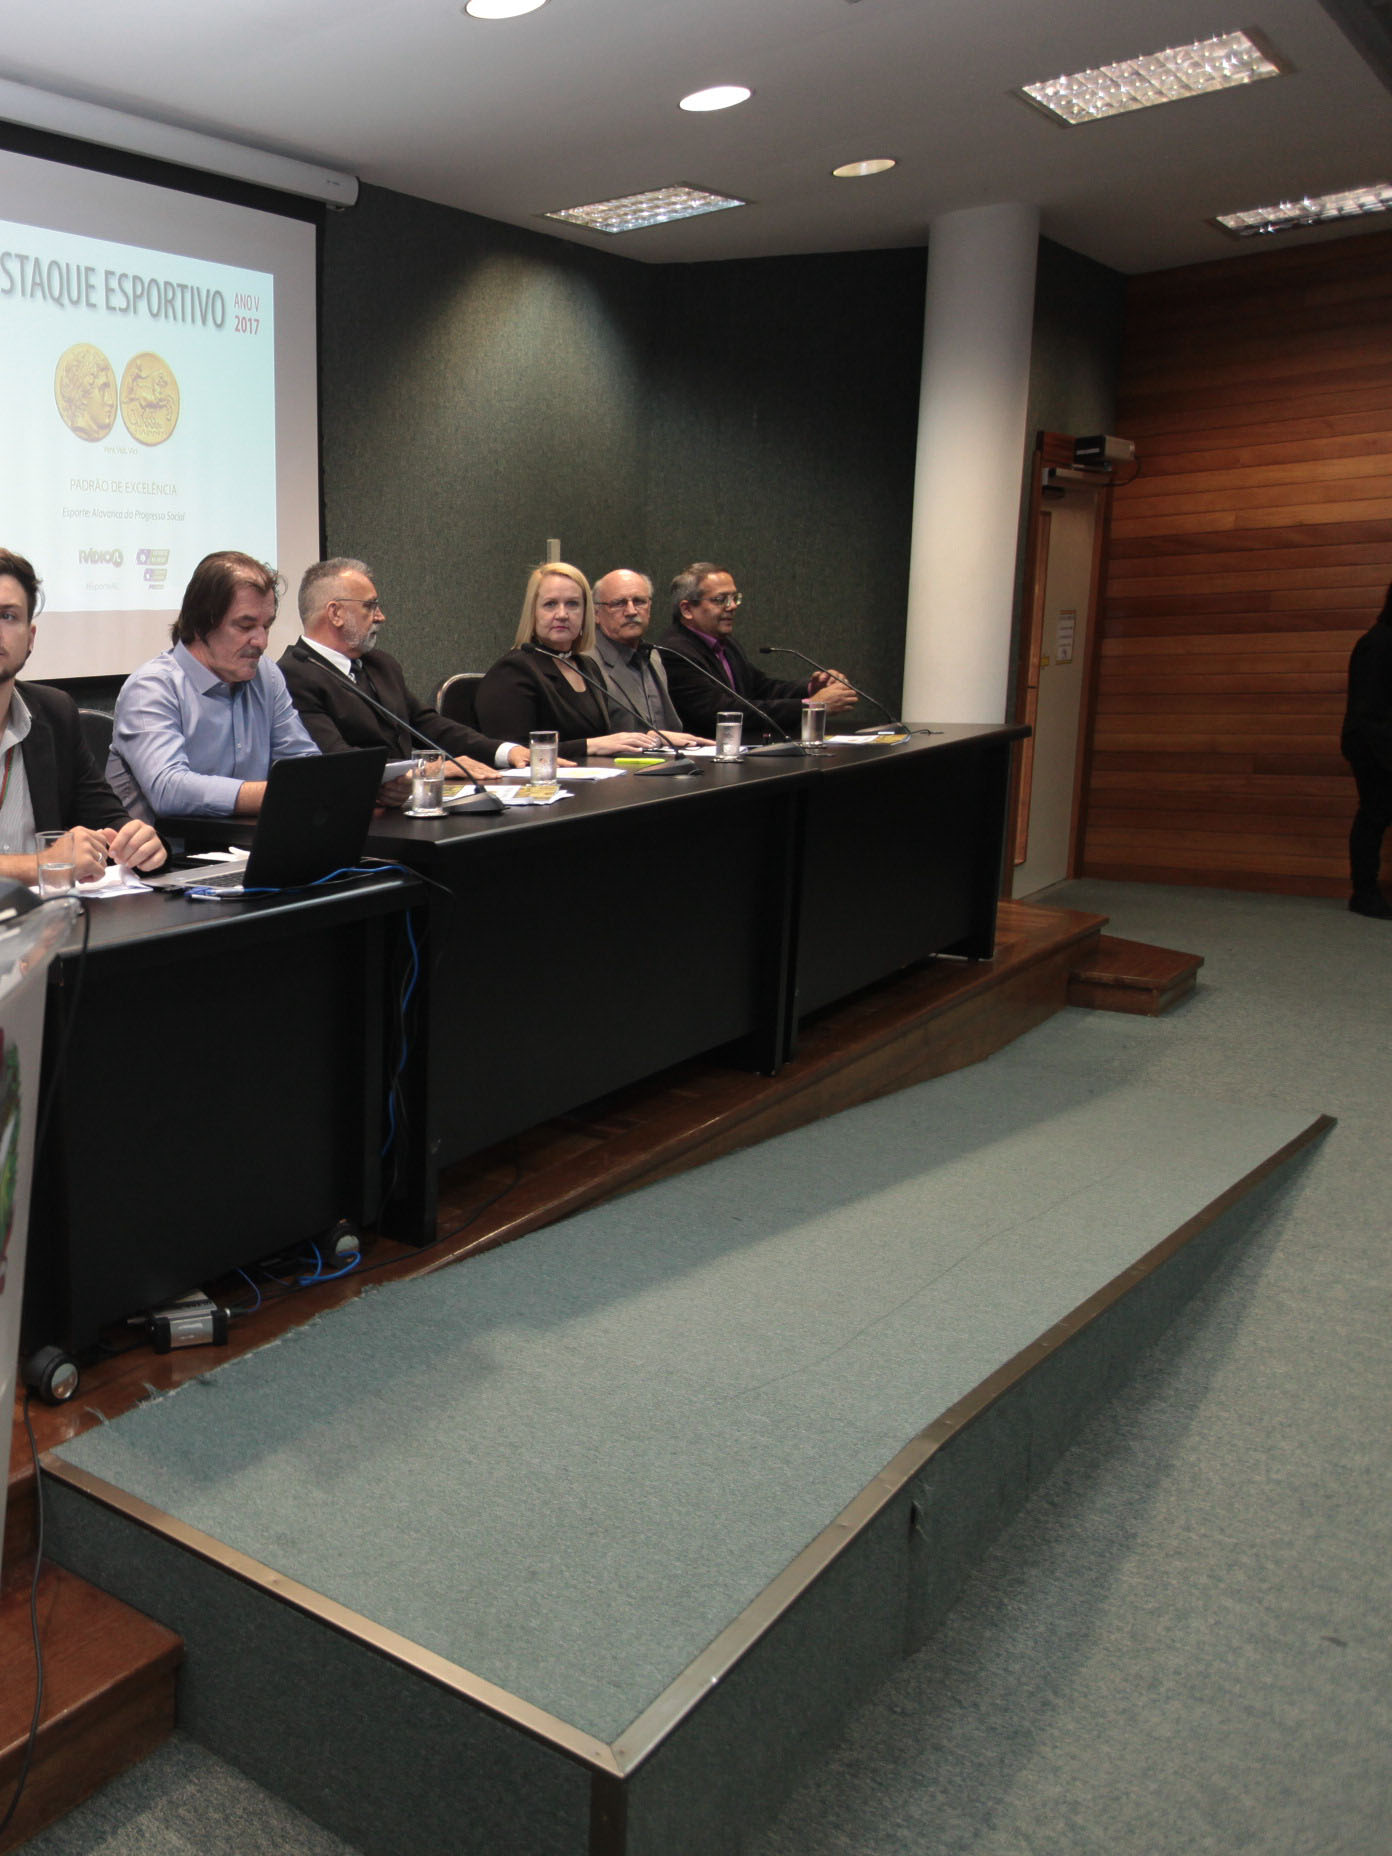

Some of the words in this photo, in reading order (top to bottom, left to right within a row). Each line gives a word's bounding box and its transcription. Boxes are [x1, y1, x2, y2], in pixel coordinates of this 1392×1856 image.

[104, 269, 225, 329] ESPORTIVO
[234, 292, 253, 311] ANO
[253, 295, 260, 313] V
[234, 315, 260, 336] 2017
[110, 480, 124, 493] DE
